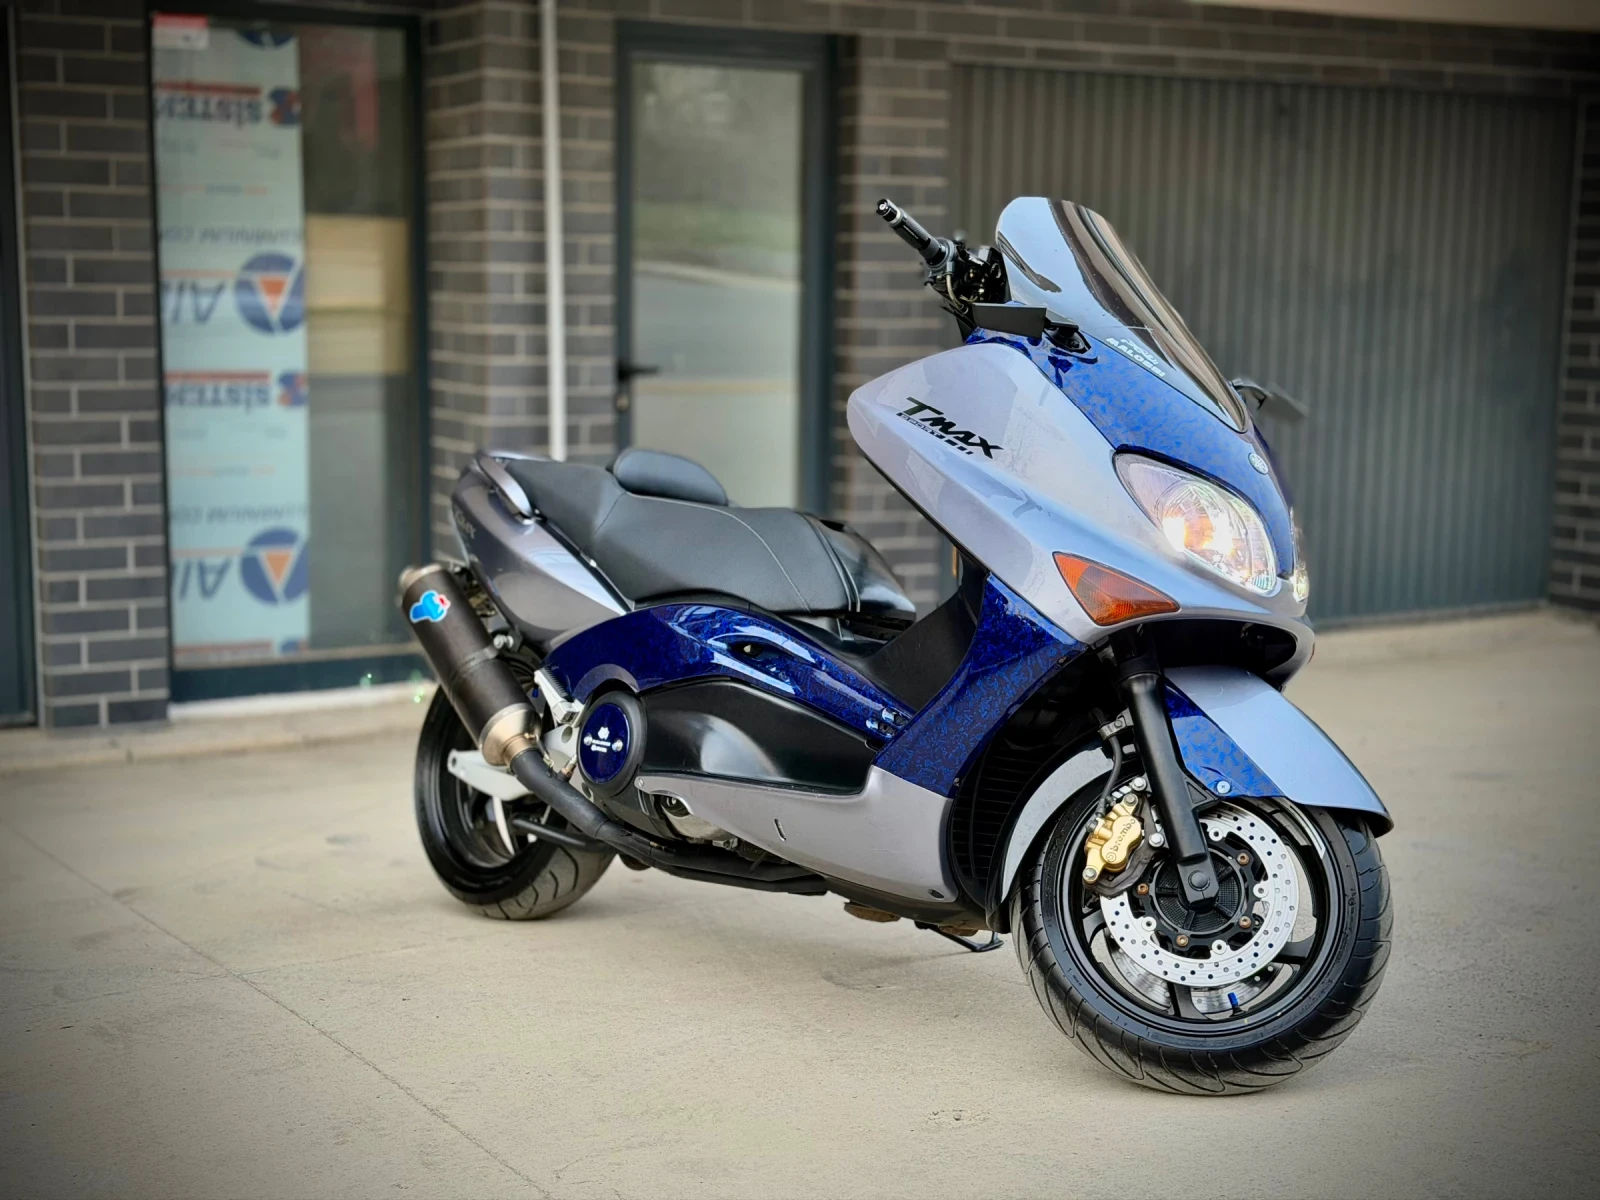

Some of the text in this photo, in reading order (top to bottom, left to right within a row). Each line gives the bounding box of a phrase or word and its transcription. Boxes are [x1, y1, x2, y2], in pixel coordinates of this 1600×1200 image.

[1105, 337, 1166, 378] MALOSSI
[902, 396, 1005, 459] TMAX
[1110, 818, 1136, 852] brembo
